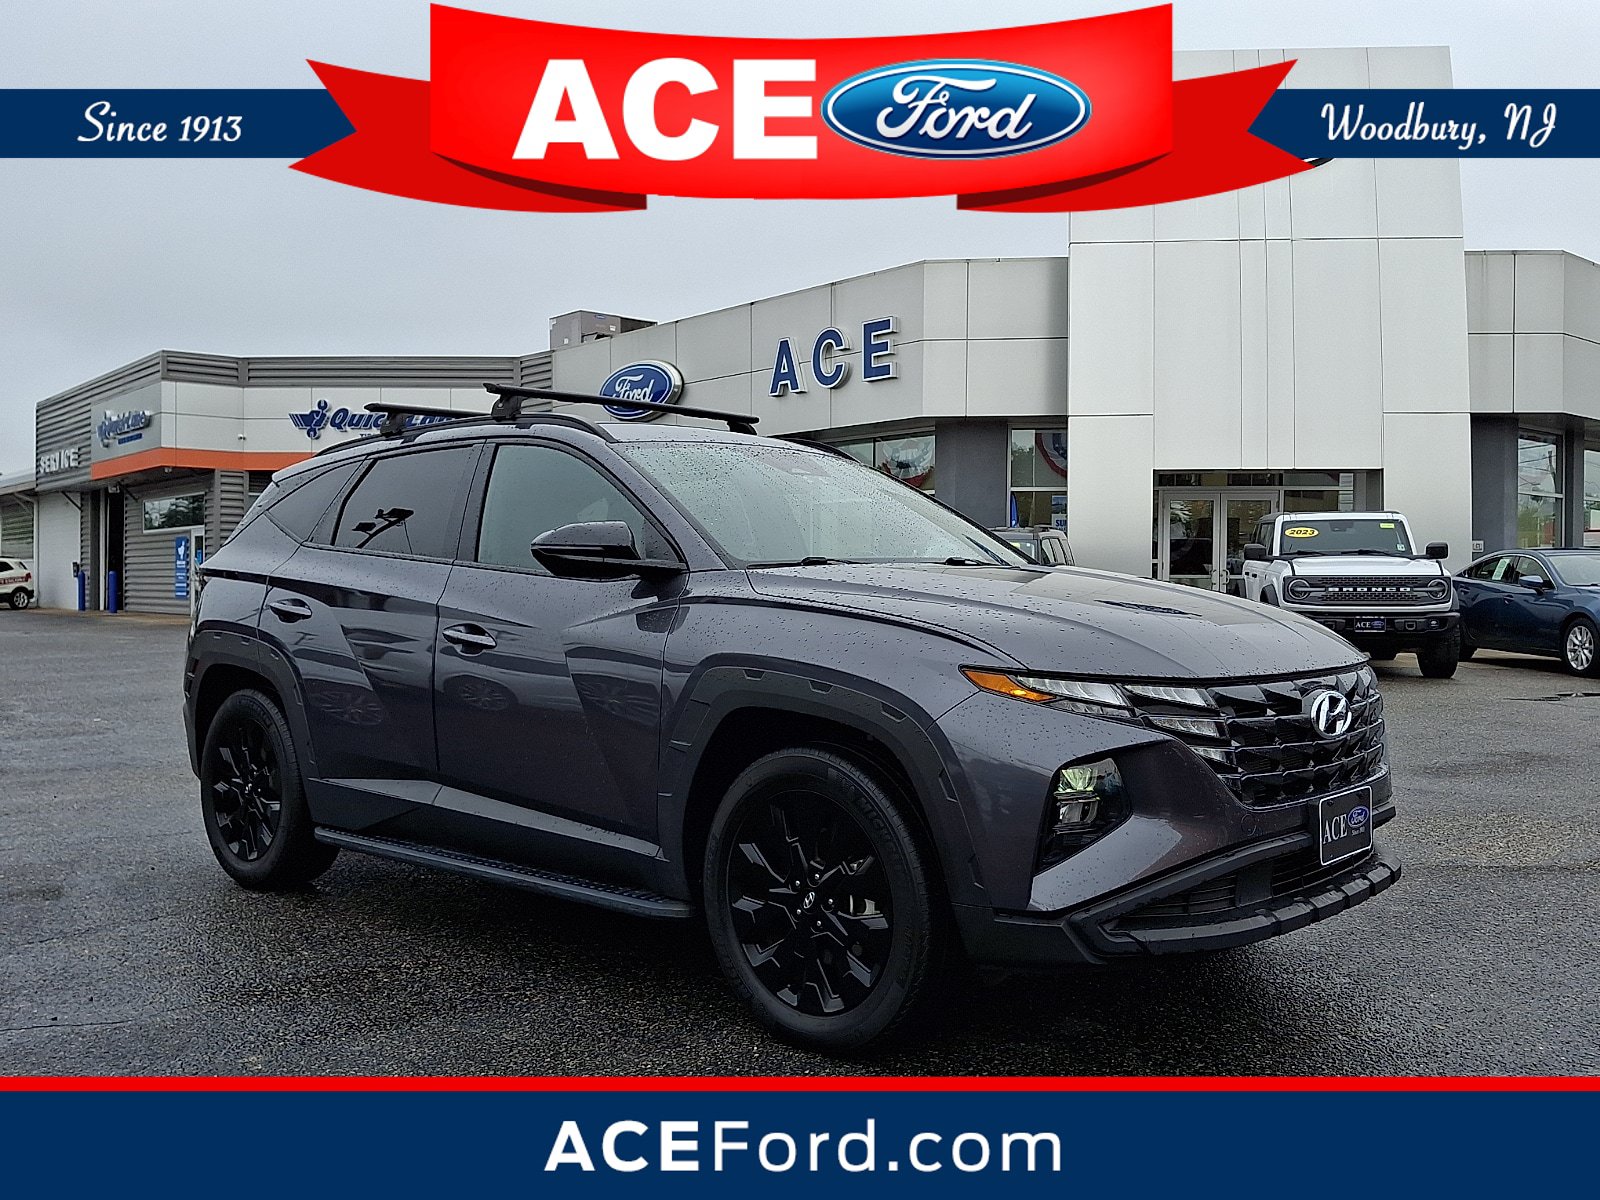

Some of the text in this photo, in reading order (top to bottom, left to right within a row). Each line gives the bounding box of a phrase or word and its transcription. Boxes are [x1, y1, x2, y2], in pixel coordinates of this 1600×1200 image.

[768, 316, 898, 397] ACE
[612, 373, 655, 403] Ford
[39, 447, 79, 474] SERVICE
[1322, 814, 1348, 845] ACE
